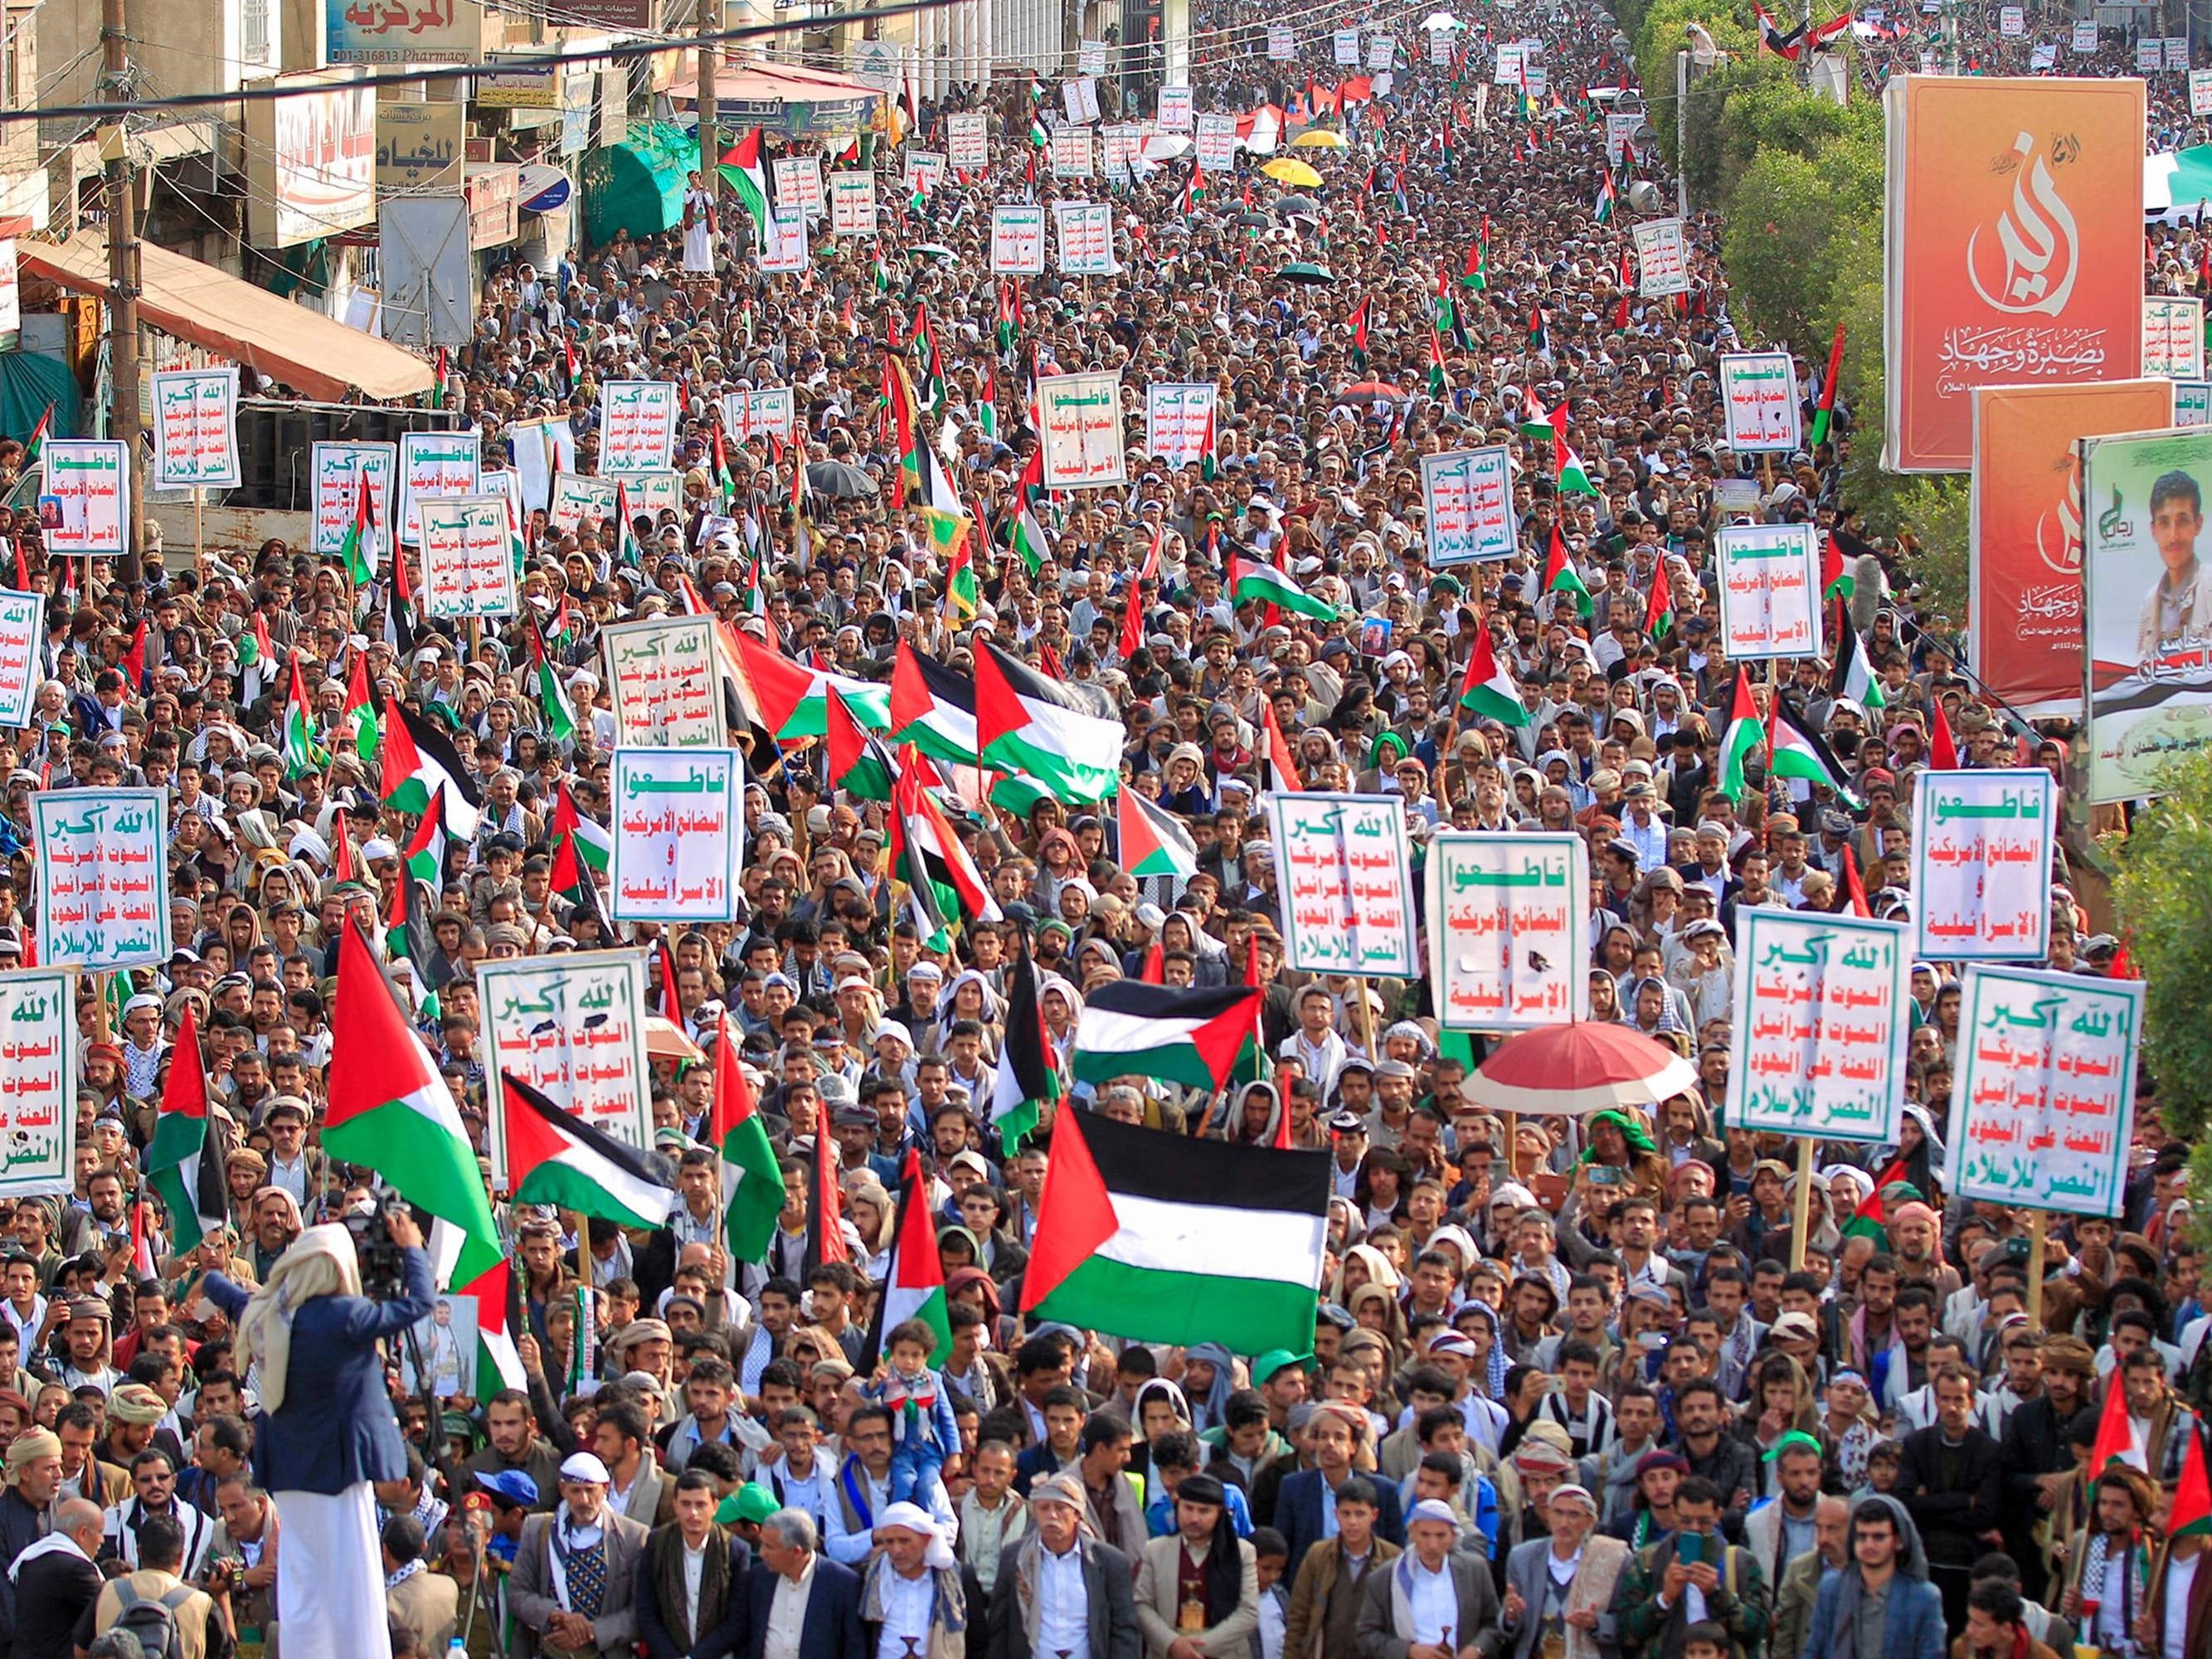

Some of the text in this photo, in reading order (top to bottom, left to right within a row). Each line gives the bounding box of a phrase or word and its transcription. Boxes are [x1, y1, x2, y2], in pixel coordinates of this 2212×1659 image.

[339, 50, 469, 64] 01-316813 Pharmacy
[1725, 535, 1803, 564] قاطعوا
[1769, 570, 1805, 592] البضائع
[1764, 598, 1768, 614] و
[622, 764, 725, 800] قاطعوا
[115, 806, 155, 830] الله
[1930, 787, 2039, 825] قاطعوا
[676, 810, 723, 838] البضائع
[1353, 810, 1391, 836] الله
[109, 842, 156, 864] الموت
[666, 845, 673, 866] و
[1349, 849, 1394, 869] الموت
[1987, 836, 2038, 867] البضائع
[110, 872, 157, 893] الموت
[1447, 857, 1564, 895] قاطعوا
[1976, 875, 1983, 898] و
[1352, 881, 1397, 899] الموت
[49, 899, 158, 924] اللعنة على اليهود
[1296, 905, 1400, 929] اللعنة على اليهود
[1511, 907, 1564, 937] البضائع
[112, 925, 158, 957] النصر
[1358, 935, 1403, 966] النصر
[1842, 938, 1892, 970] الله
[1501, 946, 1508, 968] و
[11, 990, 59, 1022] الله
[1831, 986, 1889, 1009] الموت
[2071, 1002, 2126, 1036] الله
[1829, 1024, 1885, 1046] الموت
[2, 1035, 58, 1062] الموت
[1751, 1049, 1884, 1081] اللعنة على اليهود
[2058, 1053, 2120, 1077] الموت
[2, 1070, 58, 1097] الموت
[16, 1106, 58, 1126] اللعنة
[1822, 1089, 1880, 1126] النصر
[2053, 1092, 2115, 1115] الموت
[1968, 1115, 2111, 1152] اللعنة على اليهود
[2041, 1160, 2105, 1197] النصر
